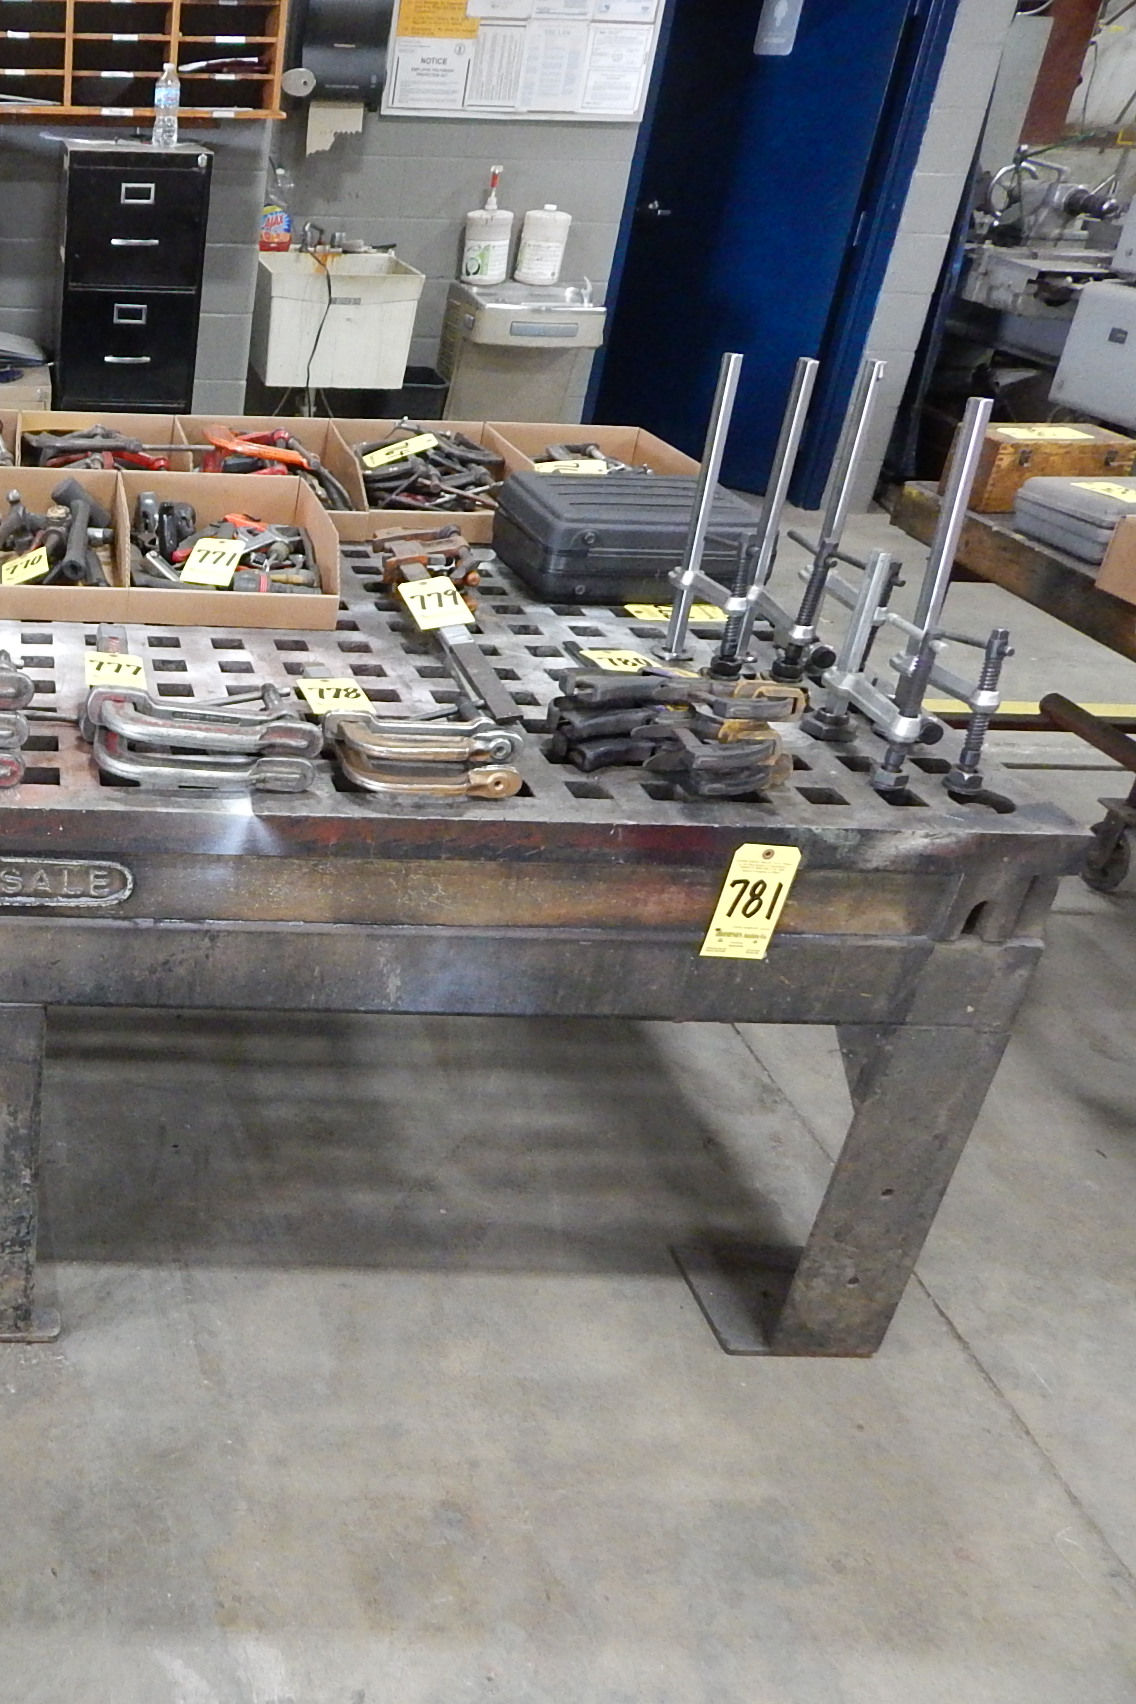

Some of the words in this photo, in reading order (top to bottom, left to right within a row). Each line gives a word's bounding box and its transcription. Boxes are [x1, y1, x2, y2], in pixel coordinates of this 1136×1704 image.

[420, 57, 448, 65] NOTICE
[5, 554, 43, 575] 770
[197, 549, 237, 567] 771
[409, 588, 459, 610] 779
[88, 659, 143, 676] 777
[596, 657, 653, 668] 780
[307, 687, 362, 700] 778
[725, 878, 784, 921] 781
